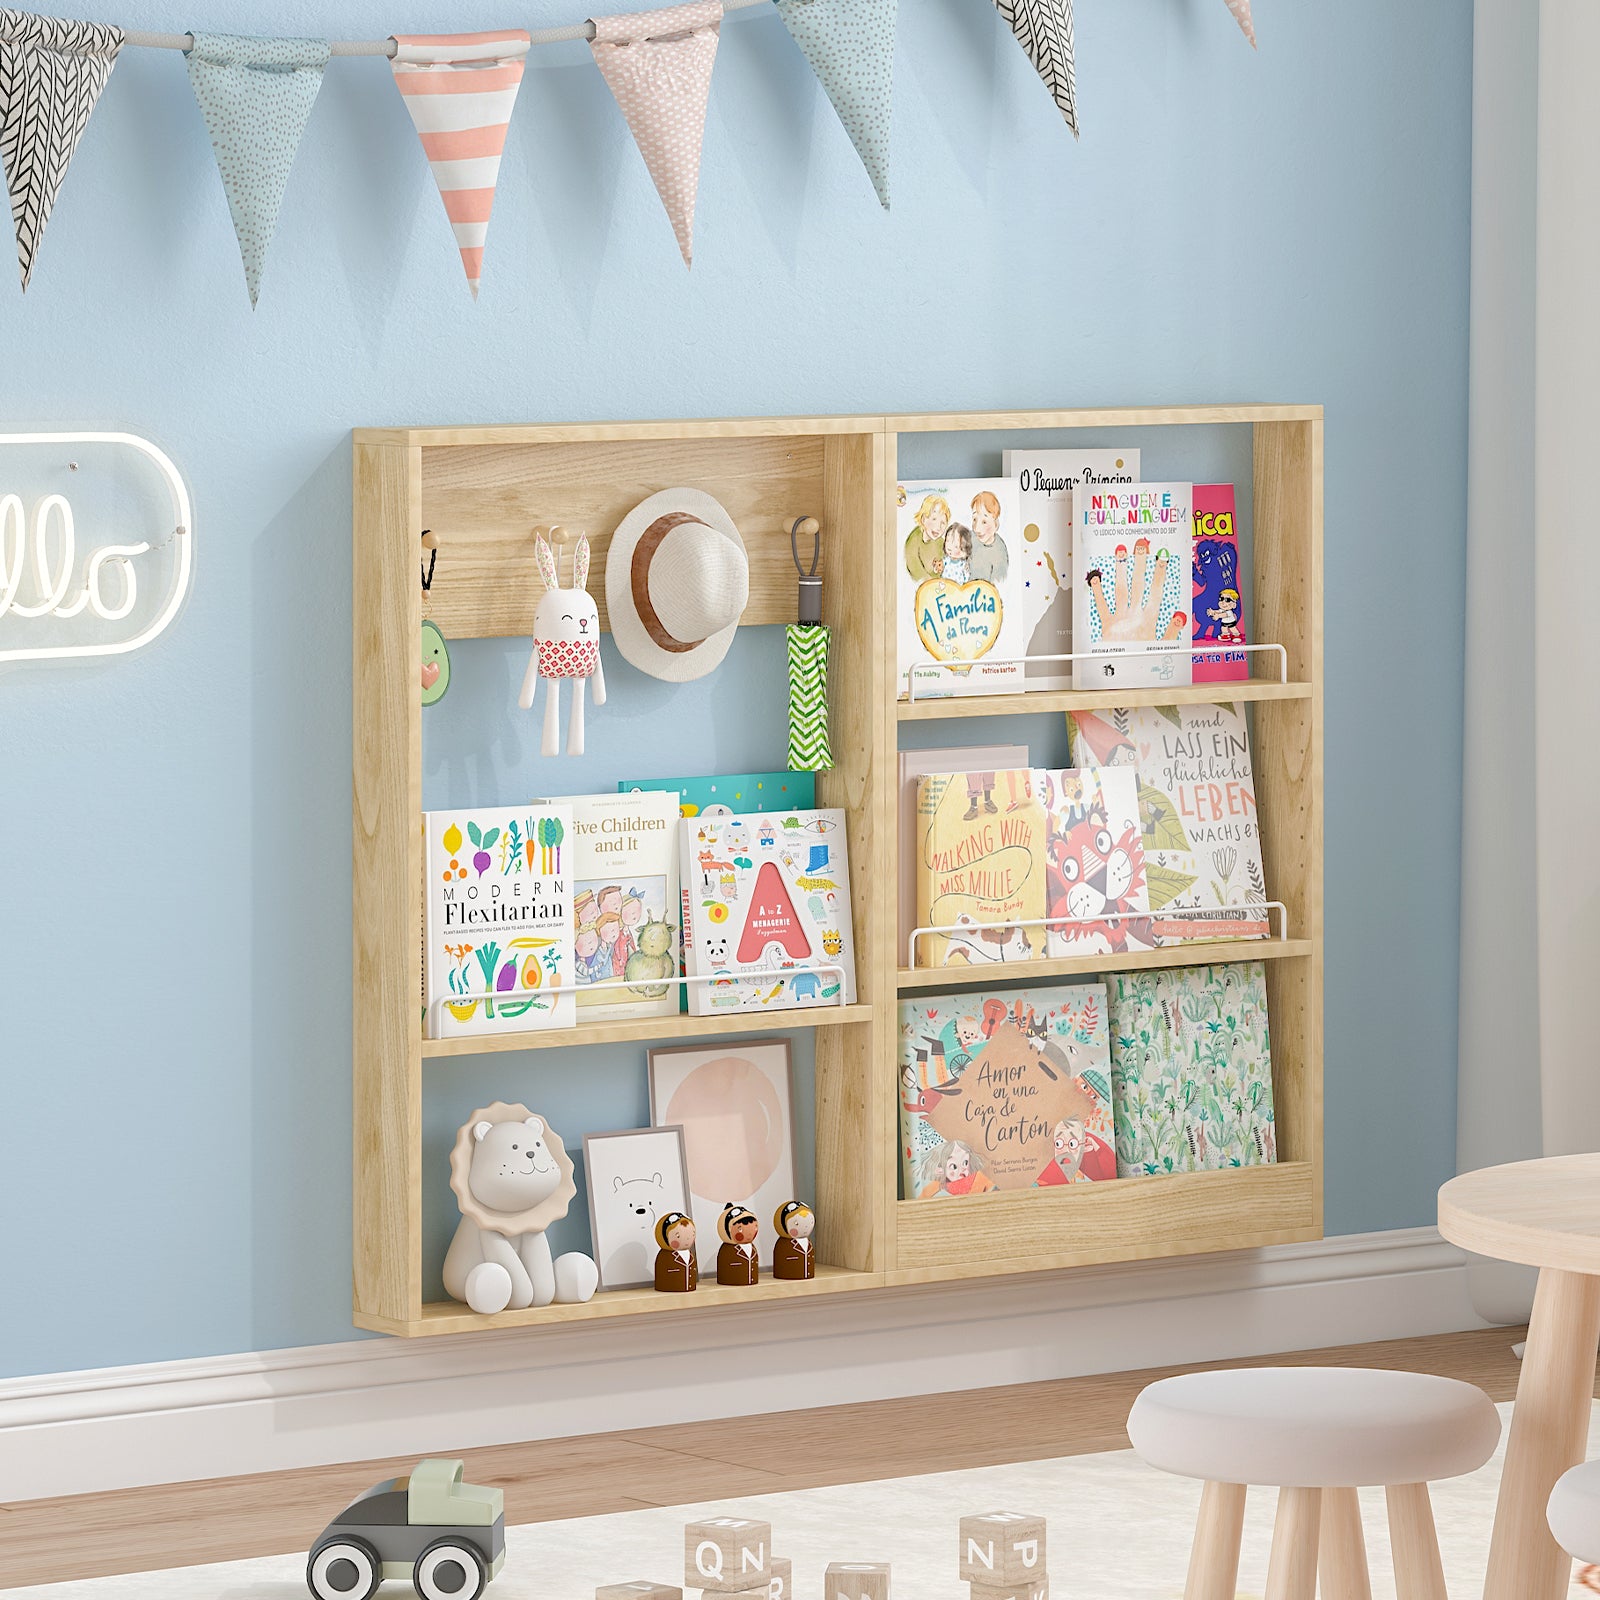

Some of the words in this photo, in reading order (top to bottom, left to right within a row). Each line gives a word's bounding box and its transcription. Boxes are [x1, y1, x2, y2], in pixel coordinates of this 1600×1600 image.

[1020, 468, 1030, 492] O
[1162, 490, 1171, 508] É
[1084, 509, 1120, 525] IGUAL
[0, 494, 150, 620] llo
[921, 608, 939, 642] A
[935, 587, 995, 622] Família
[946, 627, 957, 640] da
[960, 617, 988, 636] Flora
[1206, 654, 1221, 663] TER
[1186, 711, 1224, 728] und
[1163, 732, 1202, 758] LASS
[601, 816, 666, 833] Children
[595, 837, 623, 853] and
[628, 836, 638, 850] It
[931, 824, 994, 871] WALKING
[1000, 818, 1032, 848] WITH
[443, 880, 563, 901] MODERN
[940, 873, 965, 895] MISS
[969, 869, 1013, 898] MILLIE
[444, 897, 564, 925] Flexitarian
[682, 889, 692, 949] MENAGERIE
[759, 905, 766, 916] A
[776, 904, 782, 915] Z
[976, 901, 1001, 913] Tamara
[1003, 900, 1024, 912] Bundy
[752, 918, 790, 928] MENAGERIE
[977, 1060, 1026, 1088] Amor
[993, 1088, 1008, 1098] en
[1013, 1086, 1039, 1097] una
[965, 1100, 996, 1127] Caja
[1000, 1097, 1016, 1117] de
[985, 1115, 1052, 1151] Cartón
[695, 1540, 724, 1581] Q
[742, 1542, 764, 1574] N
[967, 1537, 994, 1570] N
[1013, 1539, 1038, 1568] P
